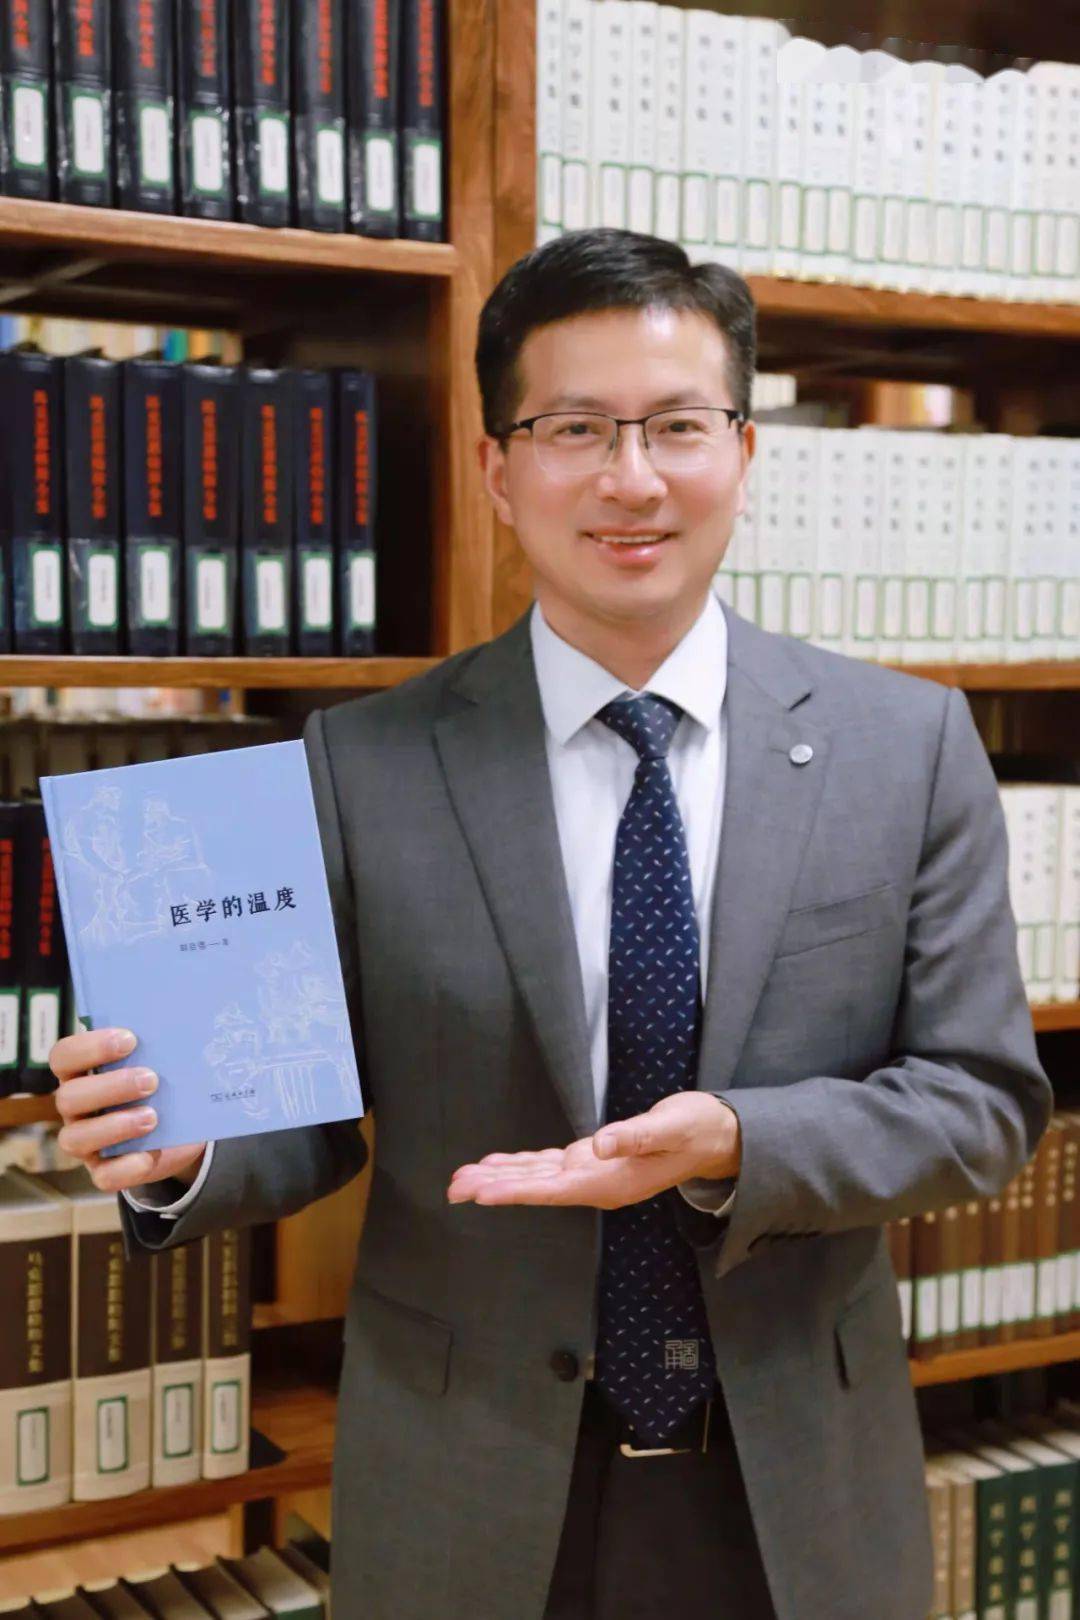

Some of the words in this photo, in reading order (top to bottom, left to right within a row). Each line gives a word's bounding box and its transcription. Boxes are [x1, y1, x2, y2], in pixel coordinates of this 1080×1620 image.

[170, 886, 297, 927] 医学的温度
